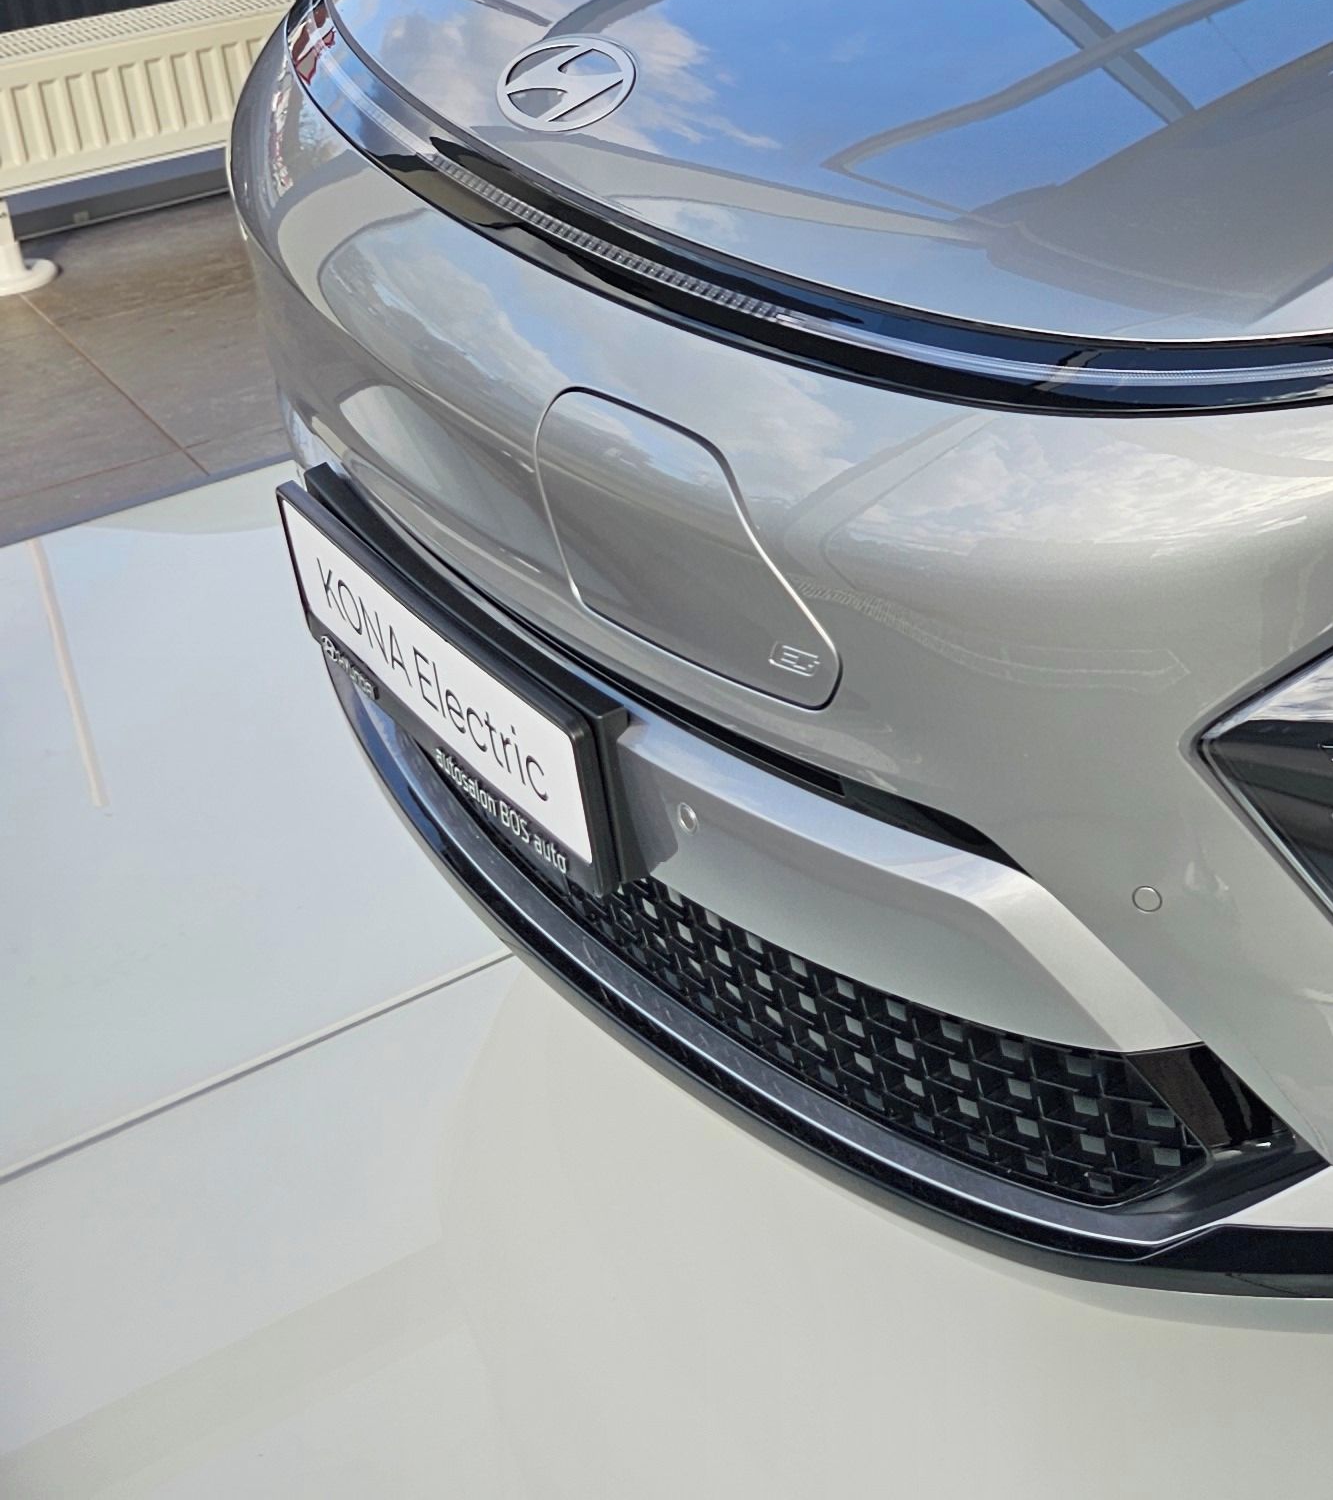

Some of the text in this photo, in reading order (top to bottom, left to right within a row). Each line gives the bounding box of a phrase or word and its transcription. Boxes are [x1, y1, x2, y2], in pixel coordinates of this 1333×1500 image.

[317, 558, 549, 801] KONA Electric
[435, 746, 567, 874] autosalon BOS auto
